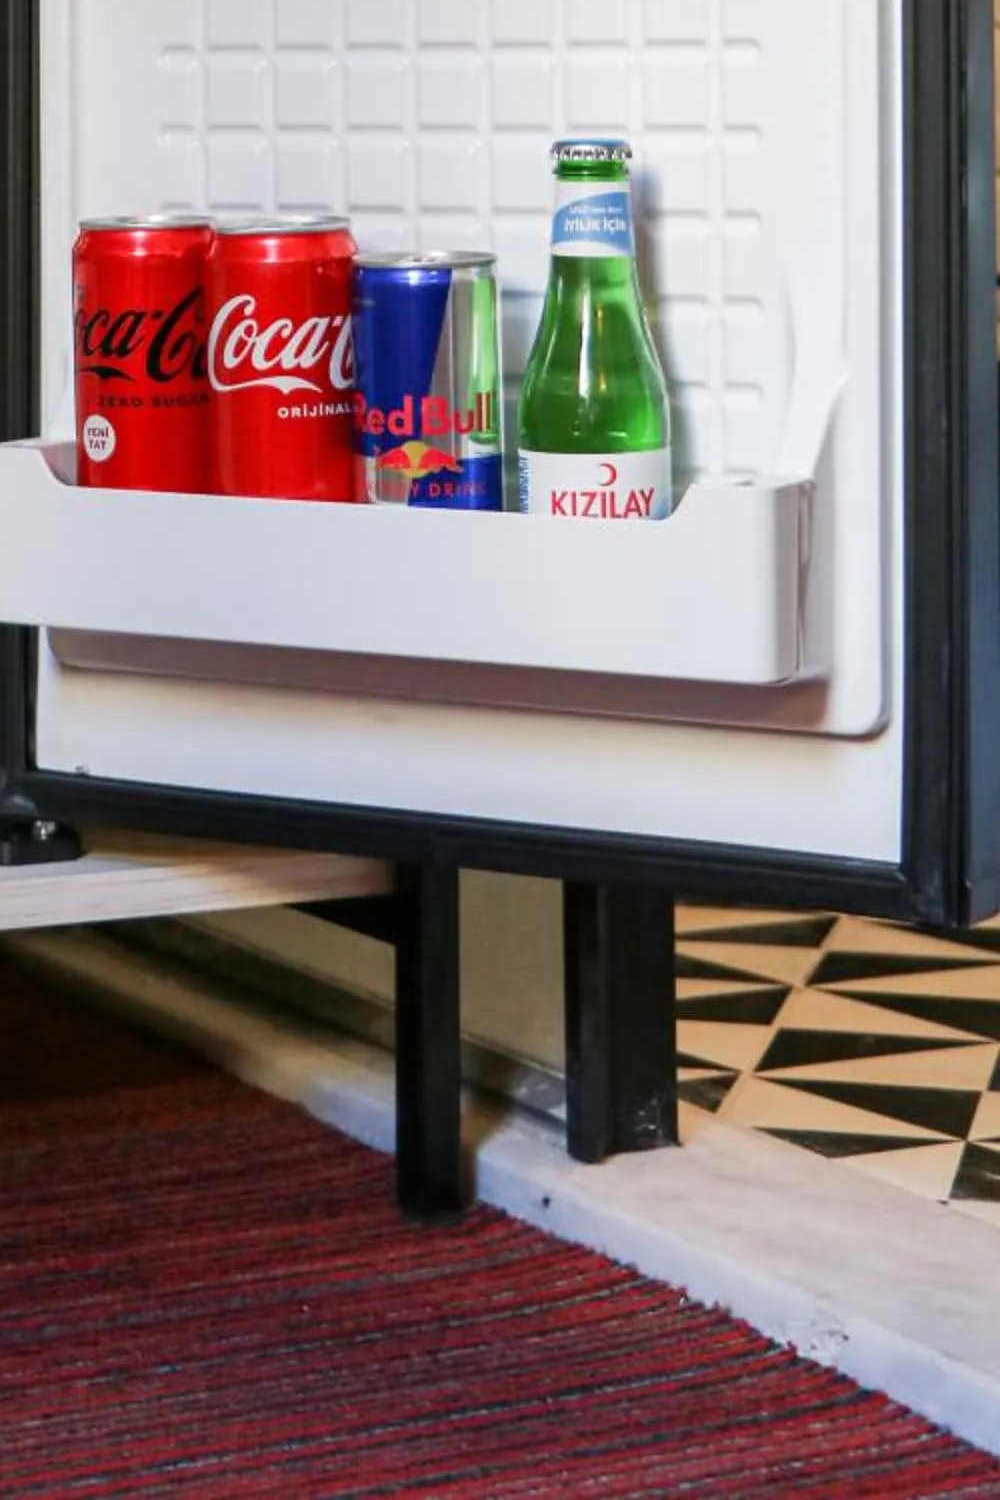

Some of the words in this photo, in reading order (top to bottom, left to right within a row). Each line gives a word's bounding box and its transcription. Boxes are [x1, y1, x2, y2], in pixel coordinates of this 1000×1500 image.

[354, 391, 414, 437] Red
[421, 390, 492, 436] Bull
[551, 487, 656, 519] KIZILAY
